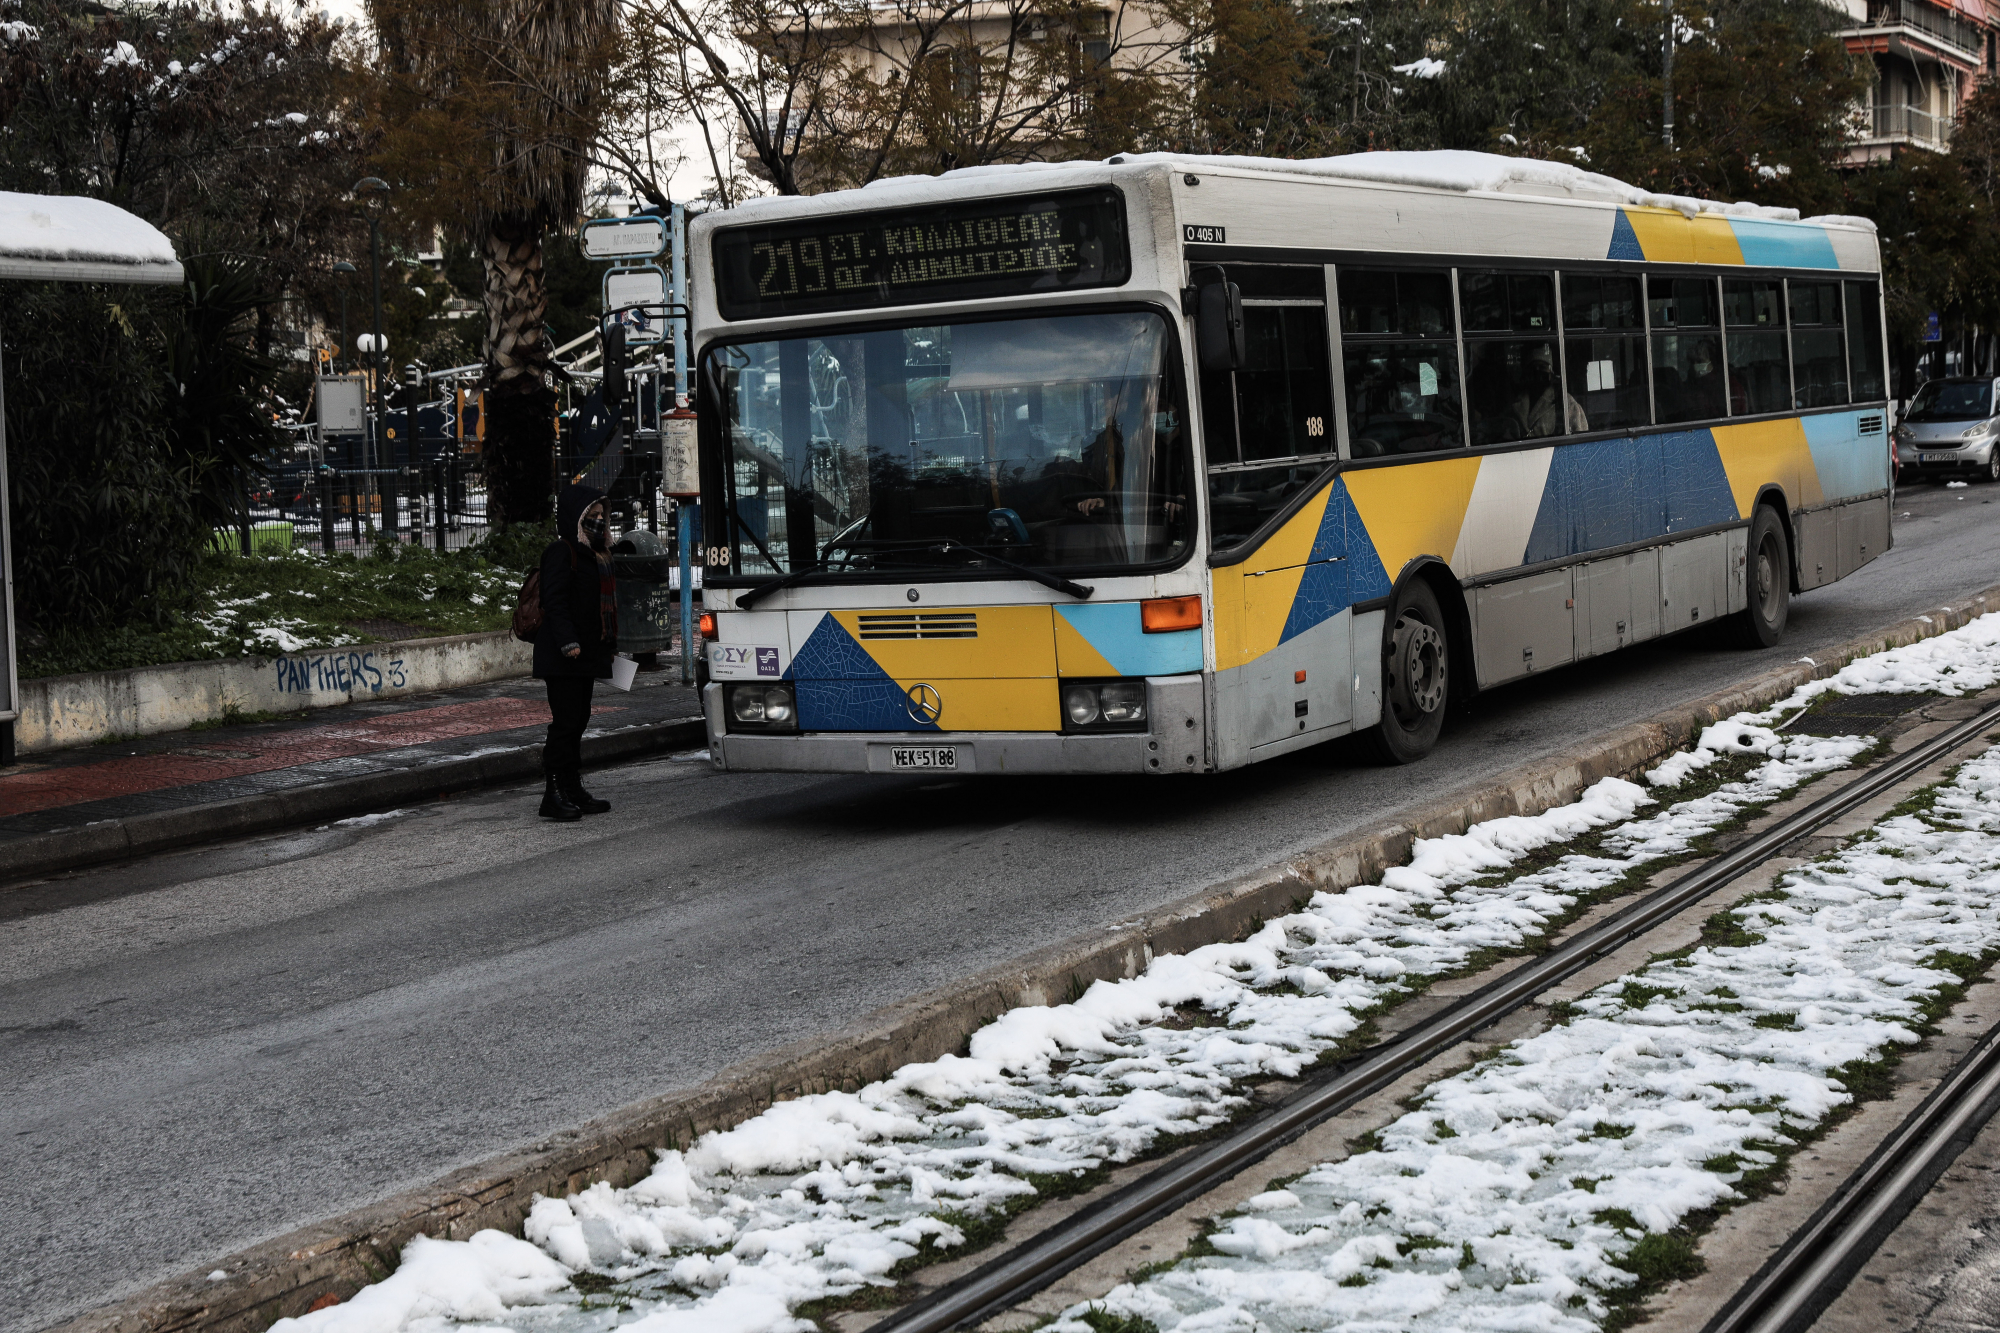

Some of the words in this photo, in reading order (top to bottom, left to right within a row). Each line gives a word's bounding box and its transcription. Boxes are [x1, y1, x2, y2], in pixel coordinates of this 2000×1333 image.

[1187, 226, 1195, 240] O
[1197, 227, 1213, 241] 405
[1215, 228, 1222, 242] N
[753, 237, 828, 297] 219
[828, 232, 877, 261] ΣΤ.
[885, 211, 1061, 255] ΚΑΛΛΙΘΕΑΣ
[1306, 416, 1324, 437] 188
[706, 546, 730, 566] 188
[276, 652, 382, 692] PANTHERS
